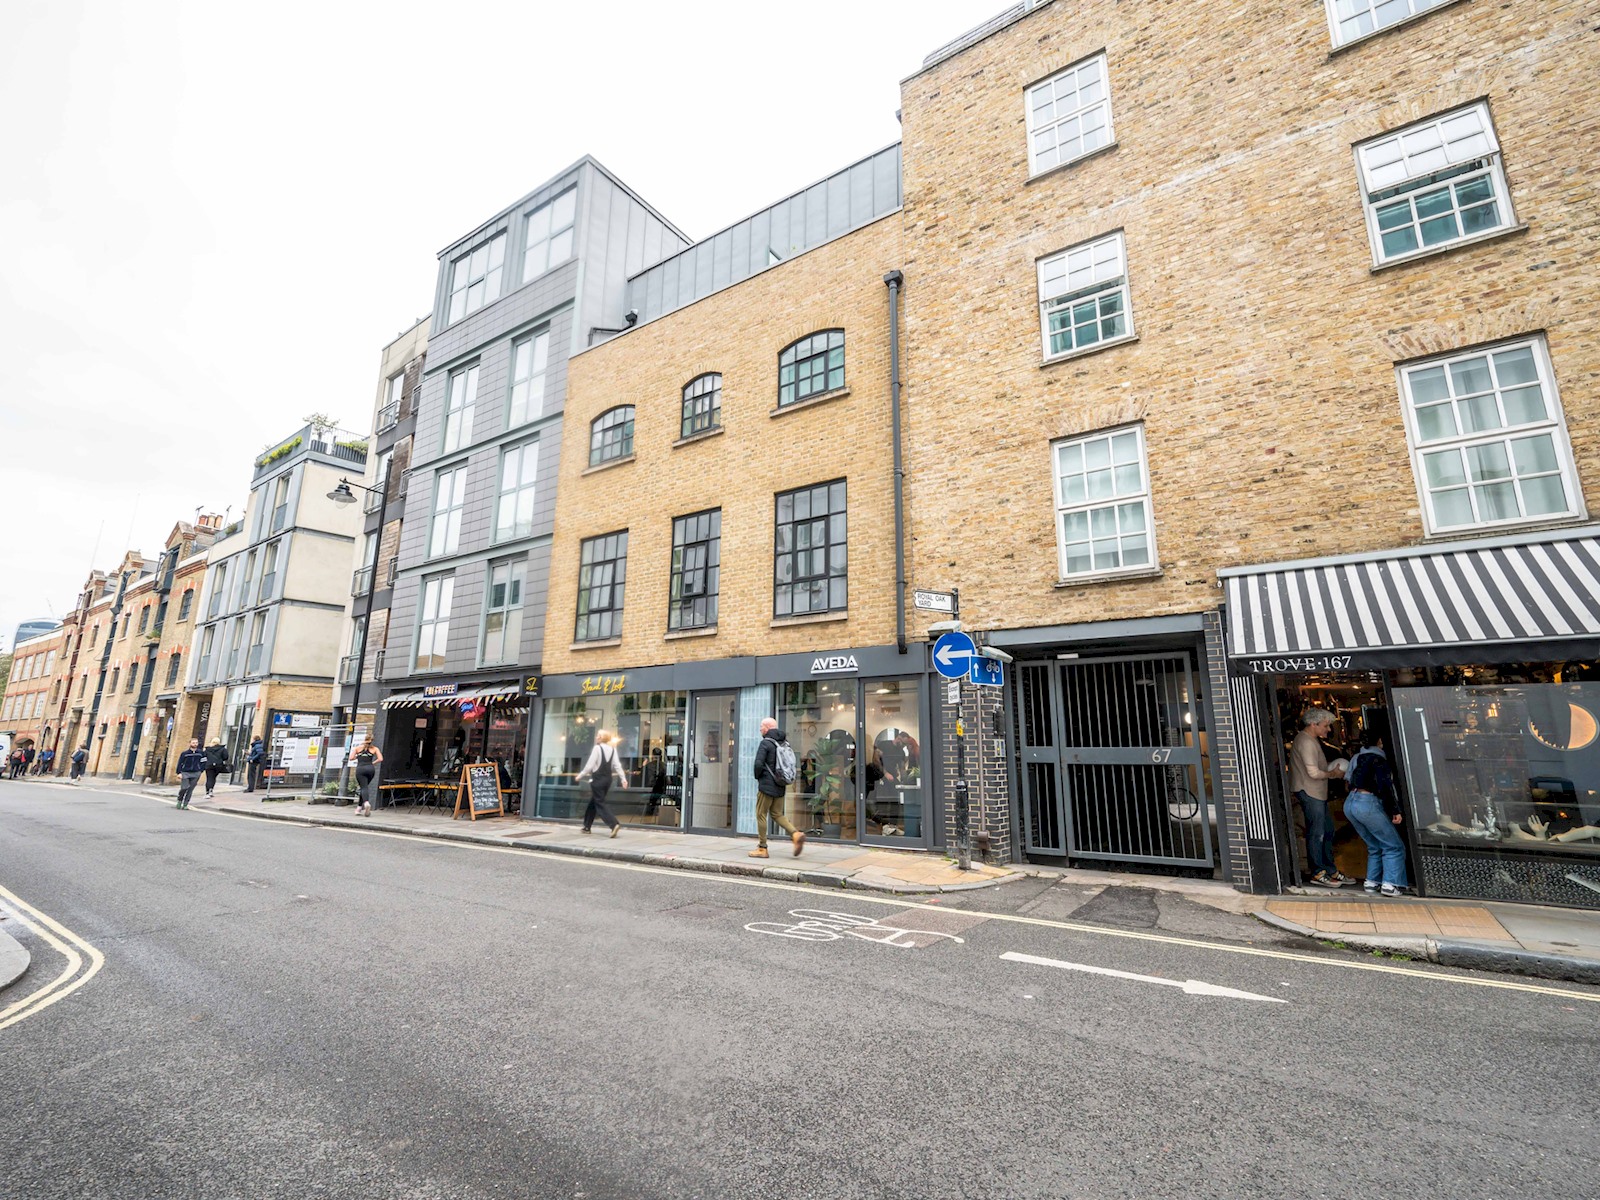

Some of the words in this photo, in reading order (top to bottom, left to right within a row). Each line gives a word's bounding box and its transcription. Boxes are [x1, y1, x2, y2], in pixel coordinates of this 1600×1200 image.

[917, 592, 933, 601] ROYAL
[811, 655, 858, 670] AVEDA
[200, 702, 210, 722] YARD
[1152, 749, 1171, 763] 67
[470, 766, 494, 774] SOUP
